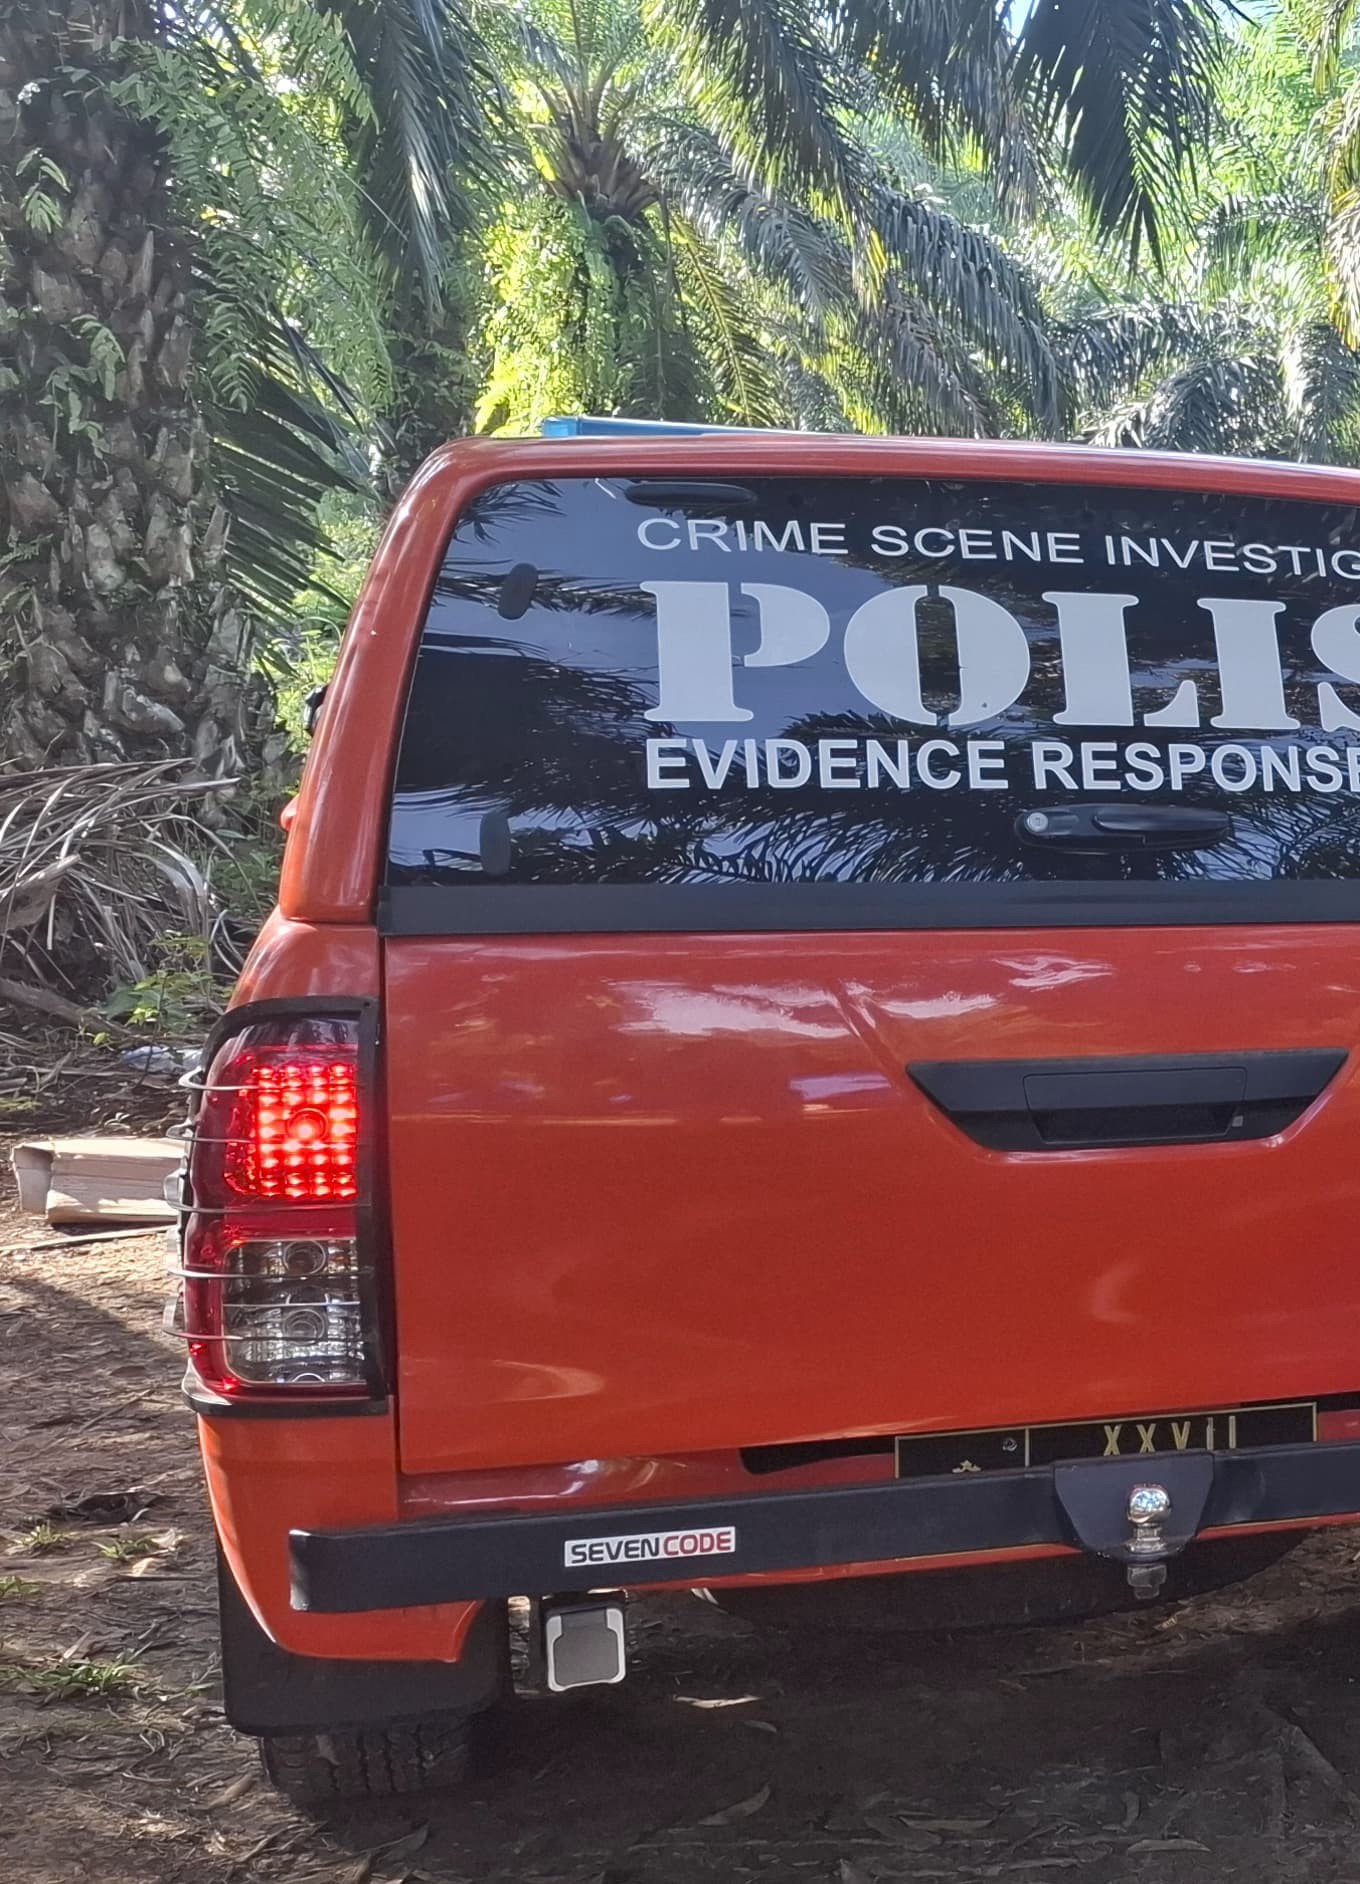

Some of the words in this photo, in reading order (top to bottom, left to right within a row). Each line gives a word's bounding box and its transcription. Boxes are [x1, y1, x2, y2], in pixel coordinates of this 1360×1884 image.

[637, 518, 849, 555] CRIME
[870, 525, 1085, 564] SCENE
[645, 738, 1009, 790] EVIDENCE
[1102, 1414, 1237, 1457] XXVII
